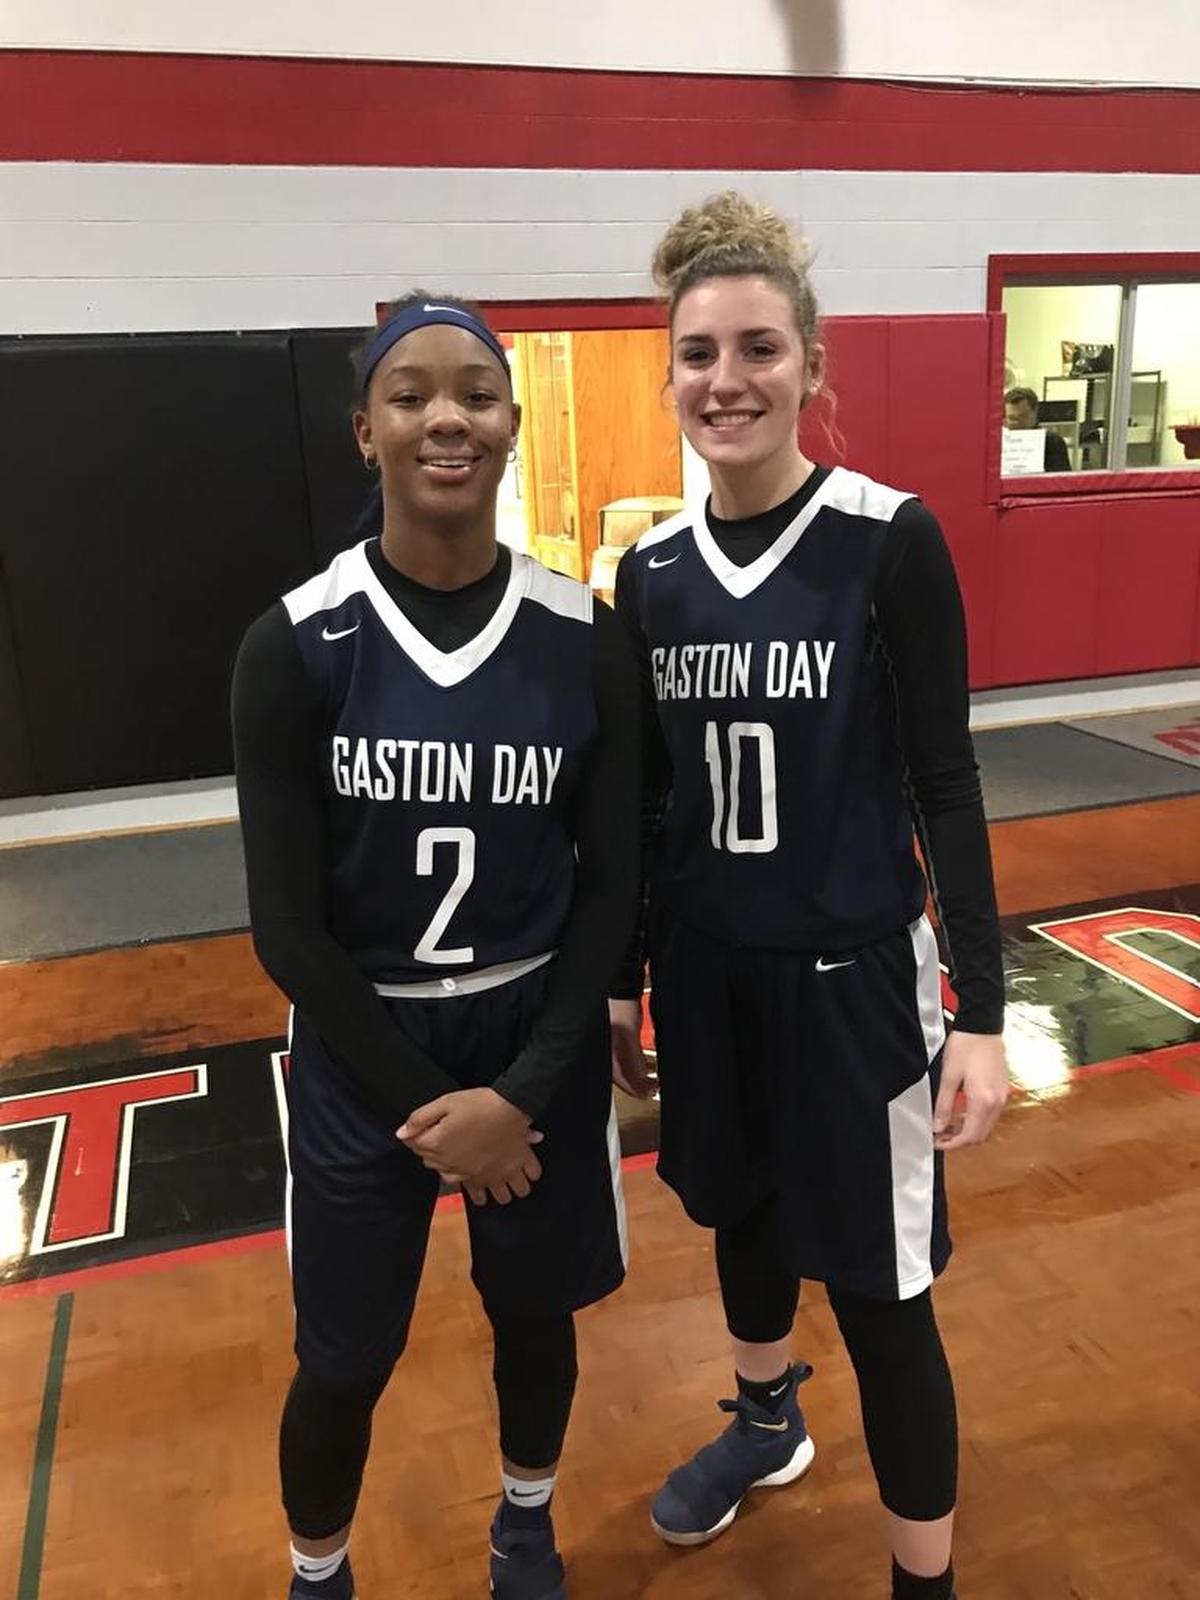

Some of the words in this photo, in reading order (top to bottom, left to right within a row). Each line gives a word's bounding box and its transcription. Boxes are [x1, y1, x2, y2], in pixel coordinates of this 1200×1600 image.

[652, 642, 753, 700] GASTON
[766, 641, 836, 698] DAY
[333, 736, 473, 802] GASTON
[492, 744, 563, 804] DAY
[705, 721, 779, 853] 10
[414, 827, 476, 964] 2
